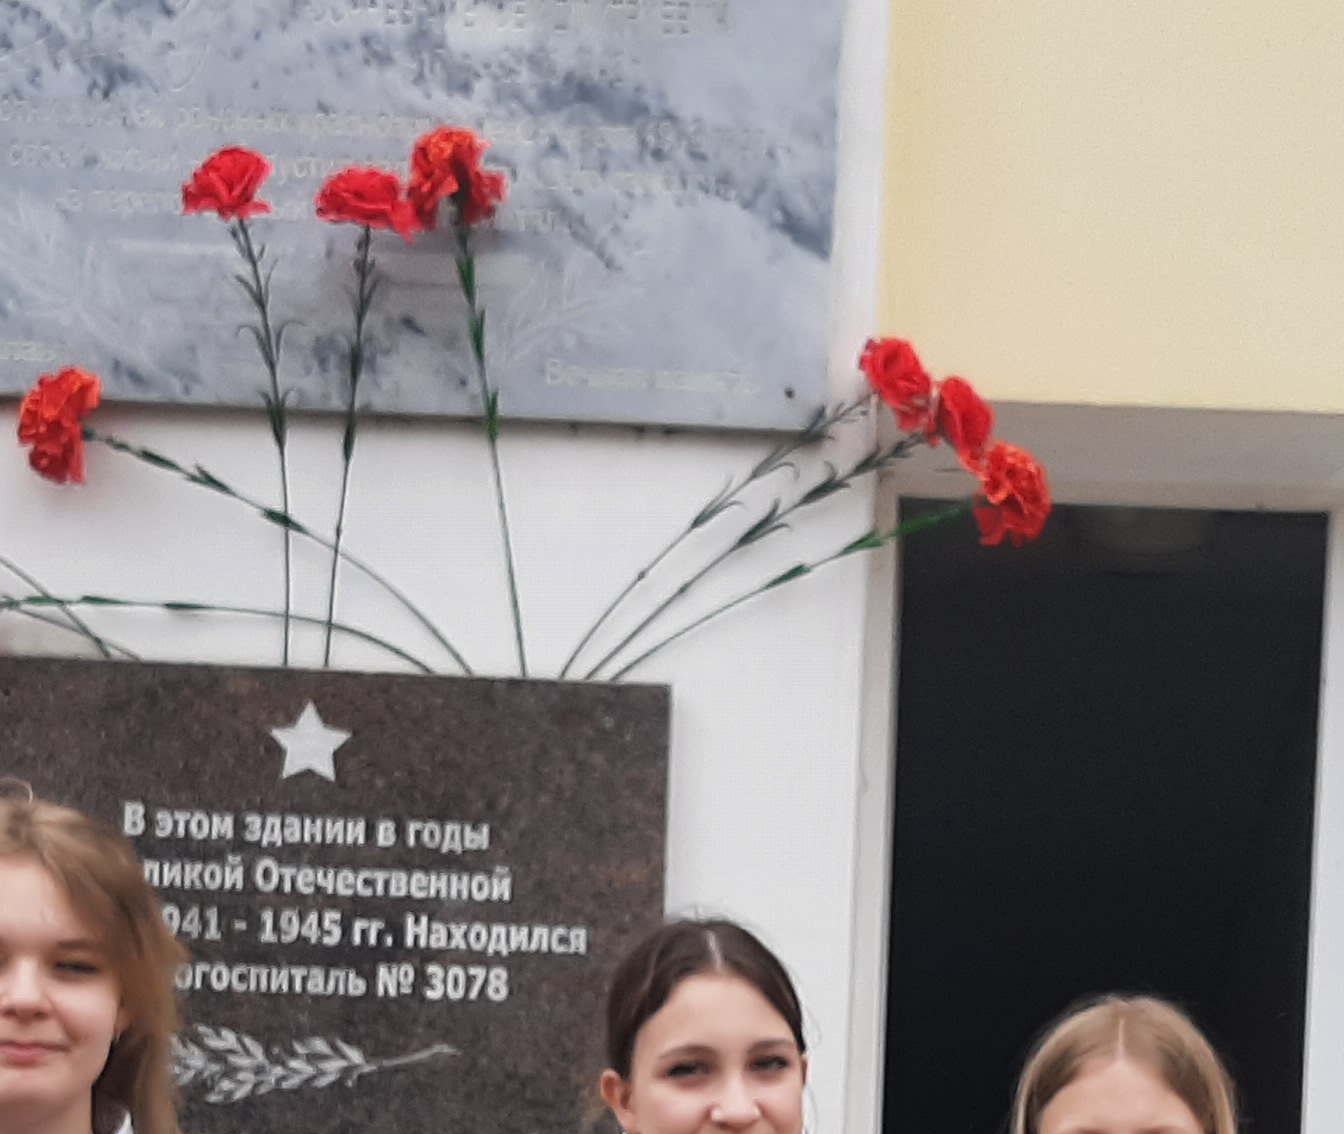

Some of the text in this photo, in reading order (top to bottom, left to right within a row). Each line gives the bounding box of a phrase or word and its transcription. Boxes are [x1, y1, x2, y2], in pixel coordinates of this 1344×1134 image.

[123, 801, 491, 855] В этом здании в годы
[144, 854, 514, 902] ликой Отечественной
[161, 904, 222, 941] 941
[259, 906, 343, 948] 1945
[351, 914, 394, 949] гг.
[404, 911, 588, 958] Находился
[174, 960, 510, 1002] огоспиталь № 3078
